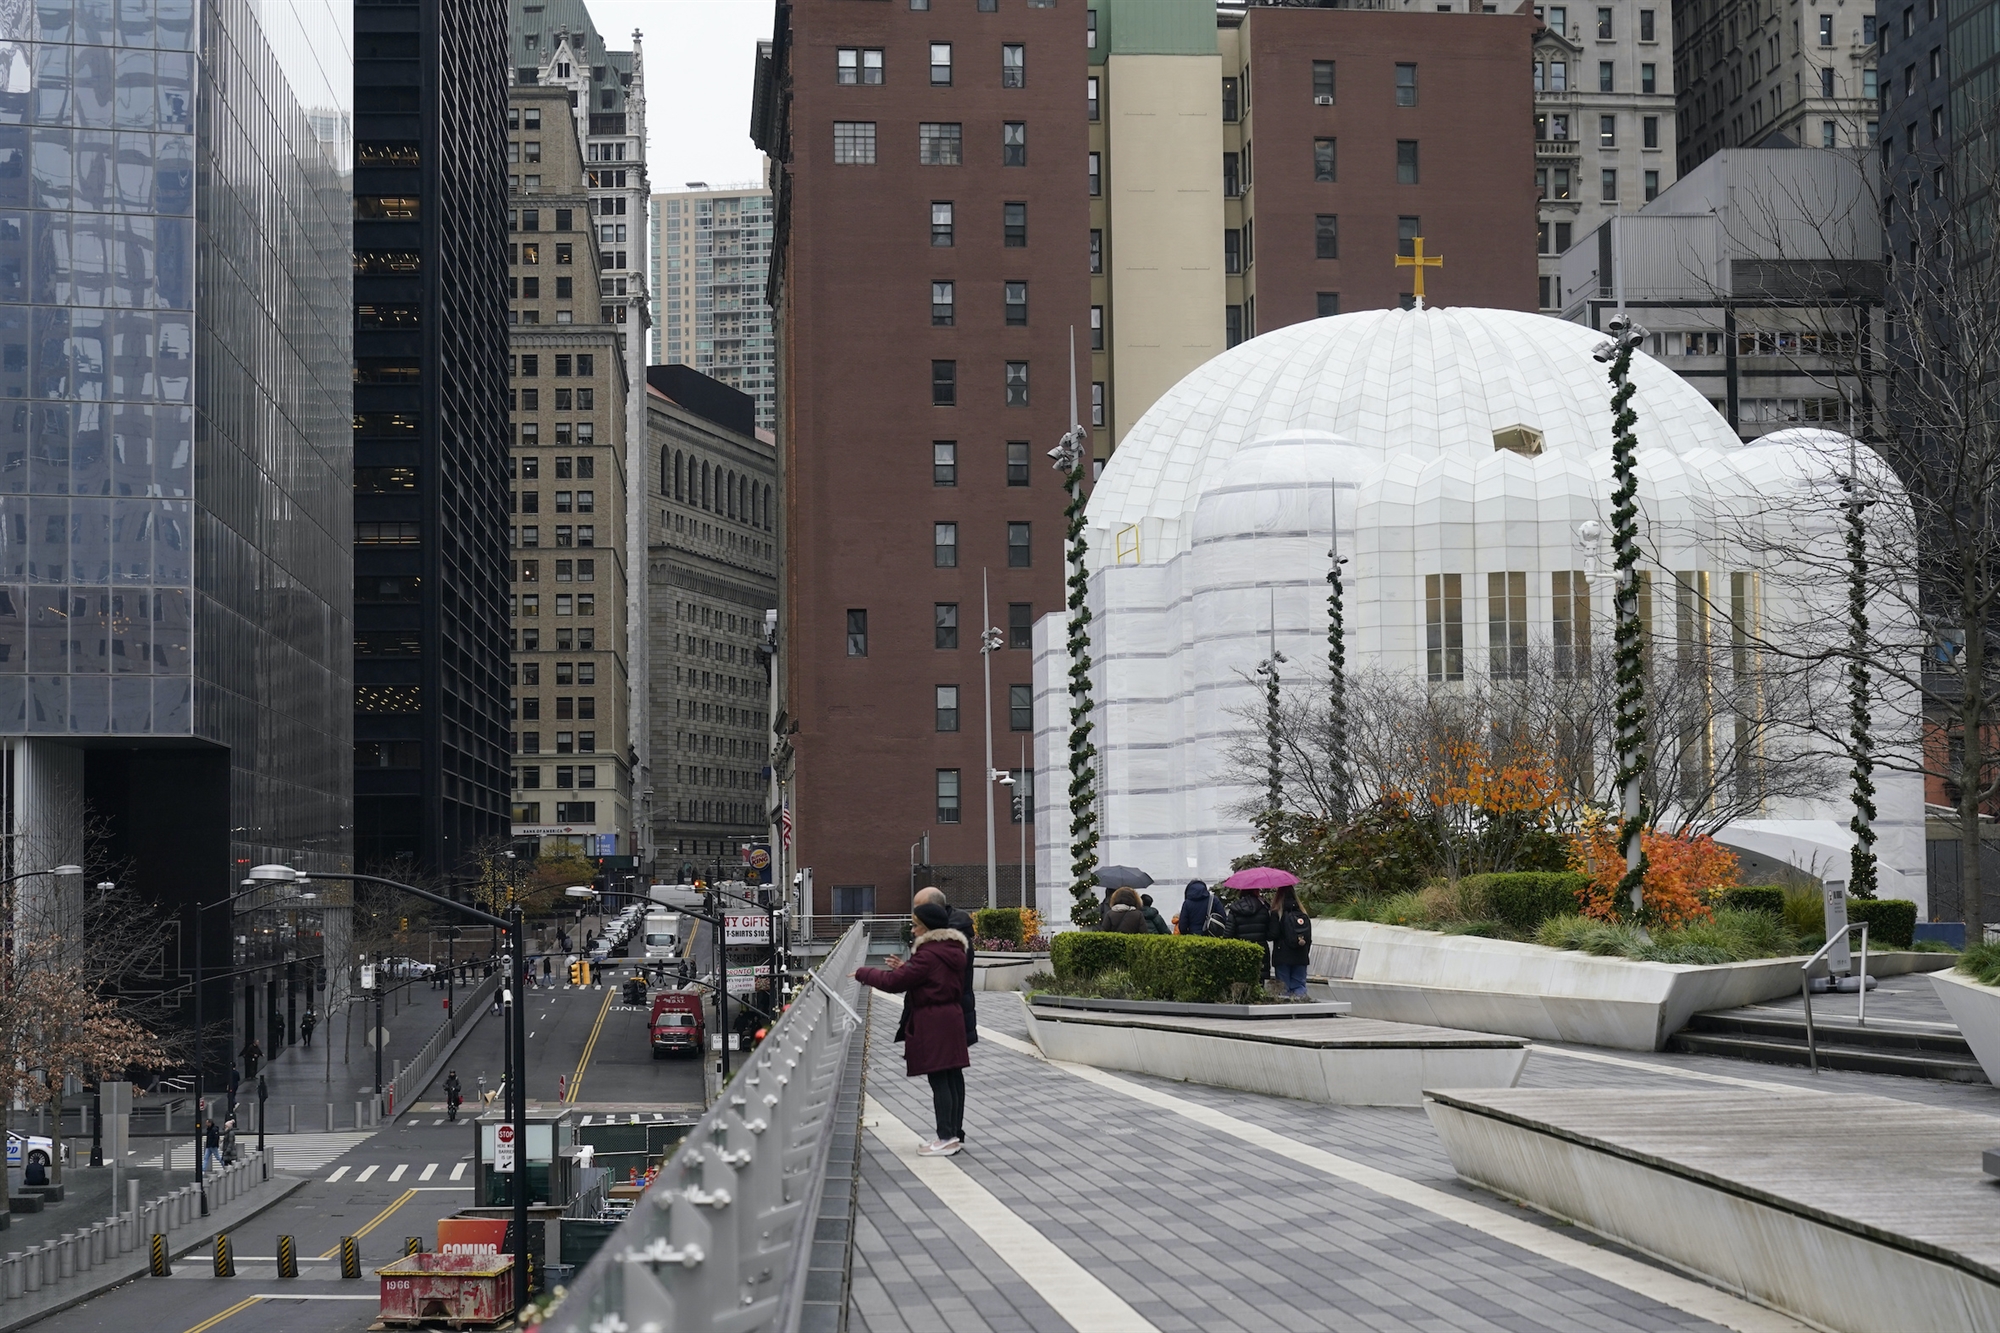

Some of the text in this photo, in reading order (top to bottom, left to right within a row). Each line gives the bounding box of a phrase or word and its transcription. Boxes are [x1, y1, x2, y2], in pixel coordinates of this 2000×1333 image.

[752, 856, 768, 865] KING
[724, 916, 770, 928] NY GIFTS
[726, 968, 752, 976] PRONTO
[442, 1243, 498, 1255] COMING
[386, 1281, 410, 1290] 1966
